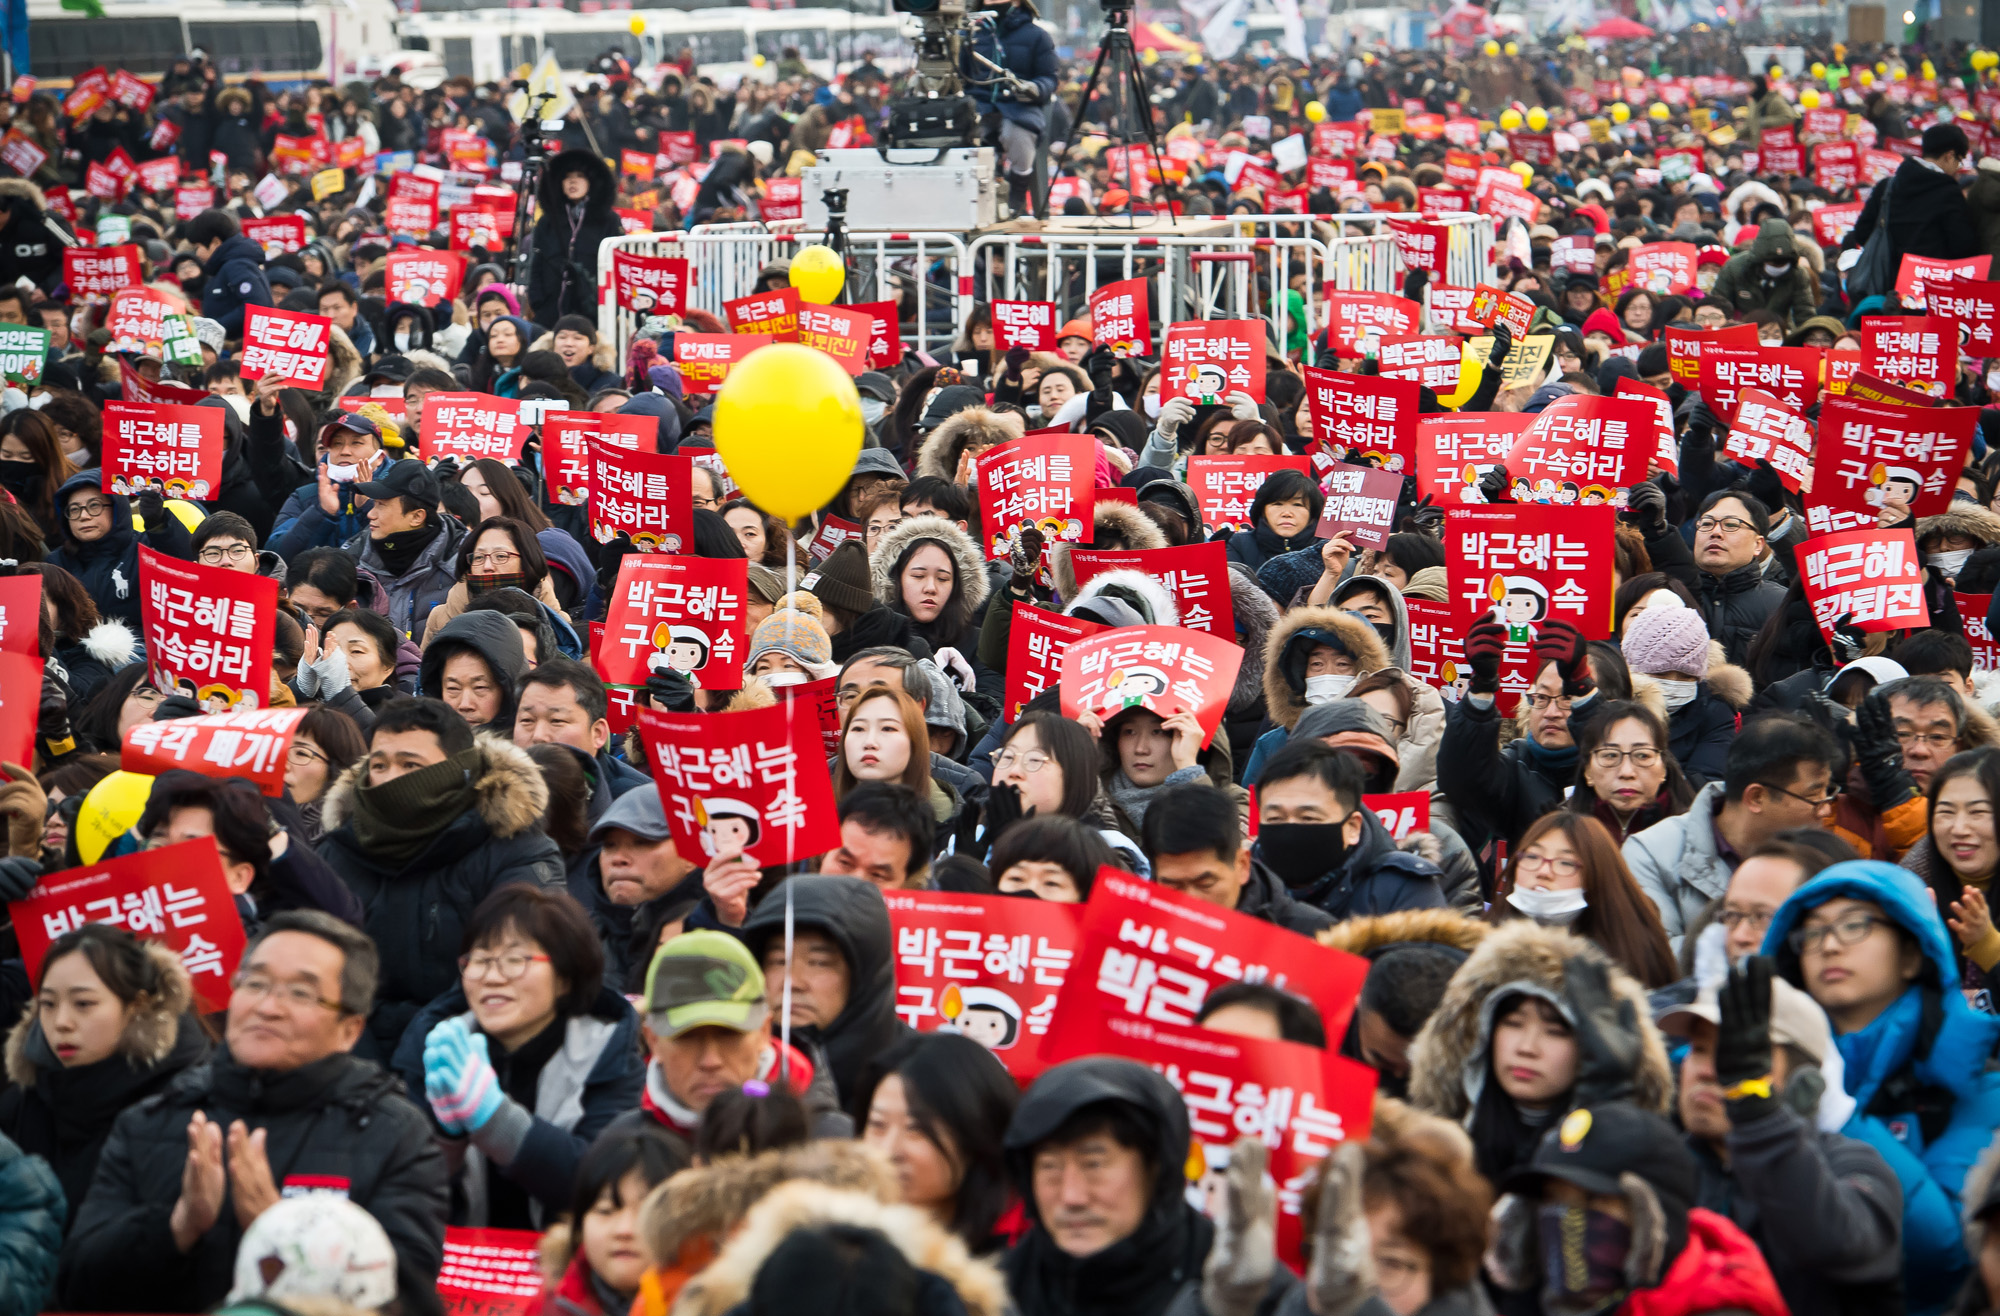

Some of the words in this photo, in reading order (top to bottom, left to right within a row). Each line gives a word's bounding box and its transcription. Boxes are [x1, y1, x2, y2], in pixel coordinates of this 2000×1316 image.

[72, 256, 129, 275] 박근혜를
[392, 260, 448, 279] 박근혜는
[1635, 251, 1690, 271] 박근혜는
[73, 274, 130, 293] 구속하라
[618, 263, 679, 289] 박근혜는
[658, 289, 677, 308] 속
[736, 298, 785, 322] 박근혜
[1927, 293, 1997, 321] 박근혜는
[799, 310, 851, 336] 박근혜
[995, 303, 1050, 325] 박근혜
[1340, 303, 1410, 330] 박근혜는
[799, 331, 858, 357] 각퇴진!!
[1003, 325, 1040, 347] 구속
[1338, 325, 1356, 346] 구
[1875, 331, 1941, 356] 박근혜를
[1973, 322, 1993, 345] 속
[679, 343, 732, 360] 헌재도
[1168, 335, 1252, 363] 박근혜는
[681, 362, 739, 381] 박근혜
[1168, 367, 1187, 390] 구
[1230, 363, 1251, 388] 속
[1716, 361, 1805, 389] 박근혜는
[1873, 355, 1940, 380] 구속하라
[1317, 387, 1399, 422] 박근혜를
[1715, 390, 1738, 411] 구
[117, 418, 202, 449] 박근혜를
[437, 405, 517, 435] 박근혜를
[1532, 414, 1630, 451] 박근혜를
[1738, 400, 1807, 443] 박근혜
[432, 430, 512, 458] 구속하라
[1319, 419, 1397, 451] 구속하라
[1435, 432, 1520, 461] 박근혜
[1842, 420, 1959, 464] 박근혜는
[116, 448, 201, 477] 구속하라
[558, 459, 589, 485] 구
[989, 455, 1073, 494] 박근혜를
[1523, 446, 1627, 484] 구속하라
[1837, 458, 1869, 490] 구
[1925, 467, 1949, 496] 속
[596, 458, 671, 502] 박근혜를
[1205, 471, 1273, 494] 박근혜
[1332, 471, 1366, 493] 박근혜
[1434, 466, 1462, 494] 구
[594, 495, 671, 531] 구속하라
[993, 487, 1074, 528] 구속하라
[1461, 532, 1589, 572] 박근혜는
[150, 579, 256, 641] 박근혜를
[628, 580, 739, 622] 박근혜는
[1462, 578, 1488, 613] 구
[1552, 577, 1589, 616] 속
[1812, 583, 1922, 639] 즉각퇴진
[1183, 603, 1213, 632] 속
[151, 622, 253, 685] 구속하라
[619, 622, 651, 660] 구
[712, 629, 736, 666] 속
[1079, 640, 1216, 679] 박근혜는
[1022, 669, 1048, 699] 구
[1077, 680, 1108, 711] 구
[1171, 678, 1206, 713] 속
[129, 725, 198, 761] 즉각
[203, 729, 285, 774] 폐기!
[655, 741, 797, 791] 박근혜는
[671, 793, 696, 837] 구
[764, 788, 807, 830] 속
[43, 882, 207, 942] 박근혜는
[181, 933, 224, 978] 속
[898, 925, 1075, 988] 박근혜는
[1097, 946, 1210, 1028] 박근
[895, 985, 938, 1029] 구
